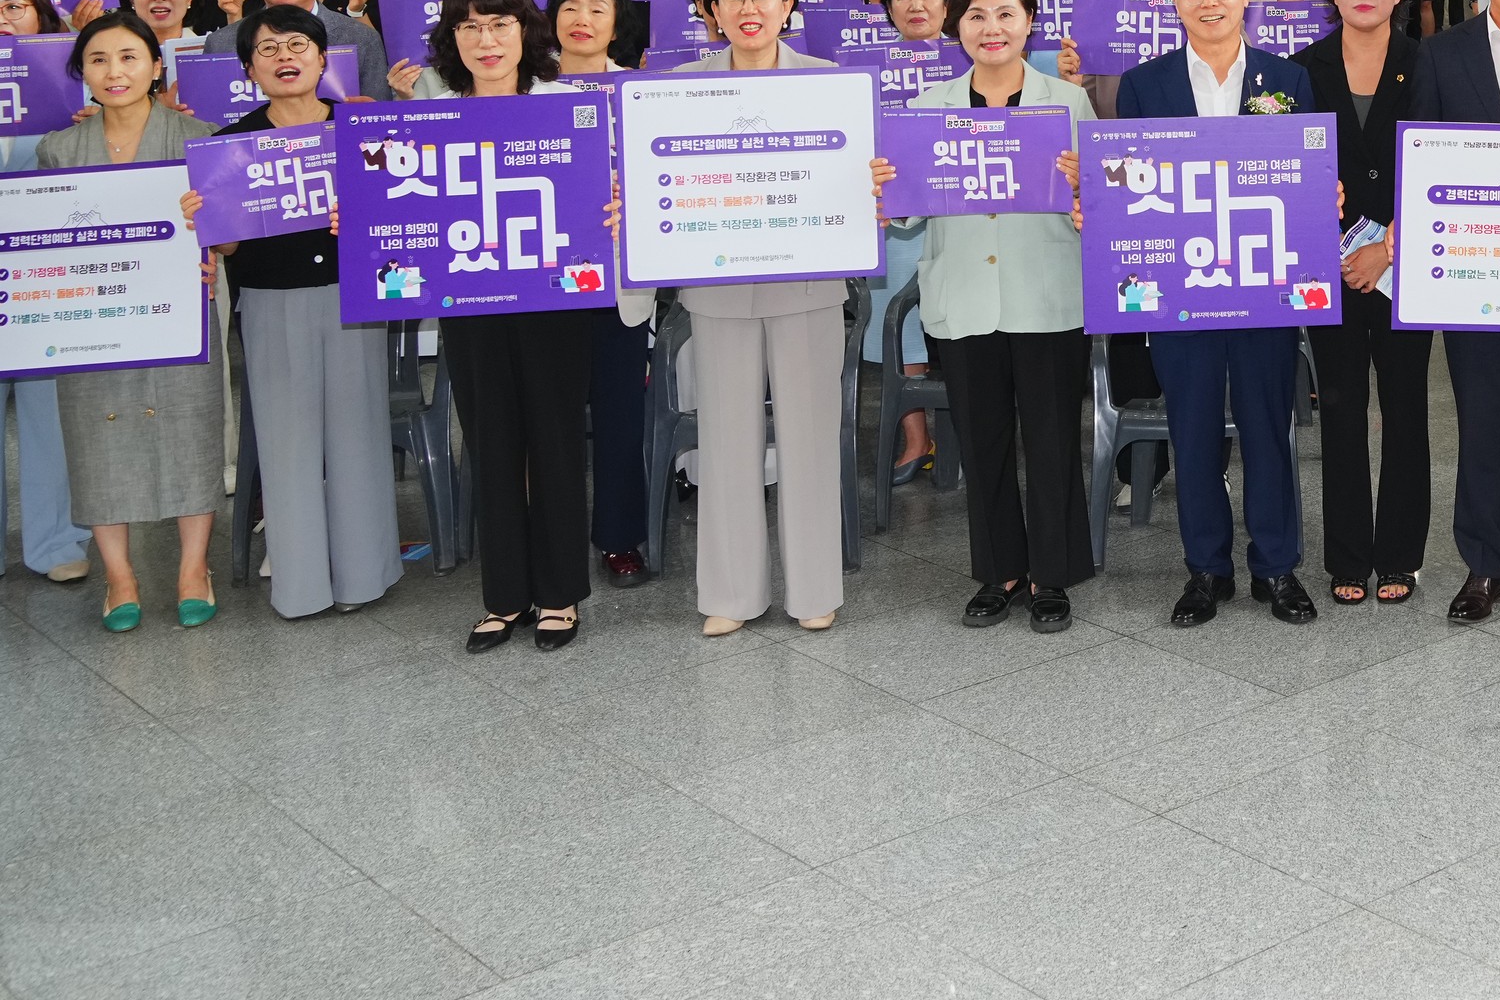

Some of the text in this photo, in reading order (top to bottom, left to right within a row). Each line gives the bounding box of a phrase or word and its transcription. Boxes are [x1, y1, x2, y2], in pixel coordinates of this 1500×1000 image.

[685, 89, 741, 97] 전남광주통합특별시
[403, 112, 461, 122] 전남광주통합특별시
[946, 119, 972, 128] 광주여성
[970, 123, 988, 134] JOB
[1142, 131, 1196, 140] 전남광주통합특별시
[503, 139, 571, 153] 기업과 여성을
[670, 135, 827, 151] 경력단절예방 실천 약속 캠페인
[504, 153, 572, 166] 여성의 경력을
[933, 140, 986, 166] 잇다
[386, 142, 498, 199] 잇다
[1237, 159, 1301, 171] 기업과 여성을
[247, 157, 304, 189] 잇다
[736, 172, 777, 183] 직장환경
[780, 170, 811, 181] 만들기
[1237, 172, 1301, 185] 여성의 경력을
[26, 185, 77, 195] 전남광주통합특별시
[963, 175, 1020, 200] 있다
[1127, 161, 1231, 215] 잇다
[766, 194, 797, 205] 활성화
[369, 223, 438, 237] 내일의 희망이
[676, 221, 718, 232] 차별없는
[801, 216, 821, 226] 기회
[824, 215, 845, 226] 보장
[9, 225, 157, 248] 경력단절예방 실천 약속 캠페인
[381, 236, 439, 250] 나의 성장이
[447, 214, 569, 273] 있다
[1111, 239, 1175, 251] 내일의 희망이
[1121, 252, 1175, 265] 나의 성장이
[1184, 233, 1298, 288] 있다
[69, 262, 108, 274] 직장환경
[111, 260, 140, 272] 만들기
[1447, 269, 1486, 280] 차별없는
[97, 284, 127, 296] 활성화
[11, 312, 50, 324] 차별없는
[129, 305, 148, 315] 기회
[151, 303, 171, 314] 보장
